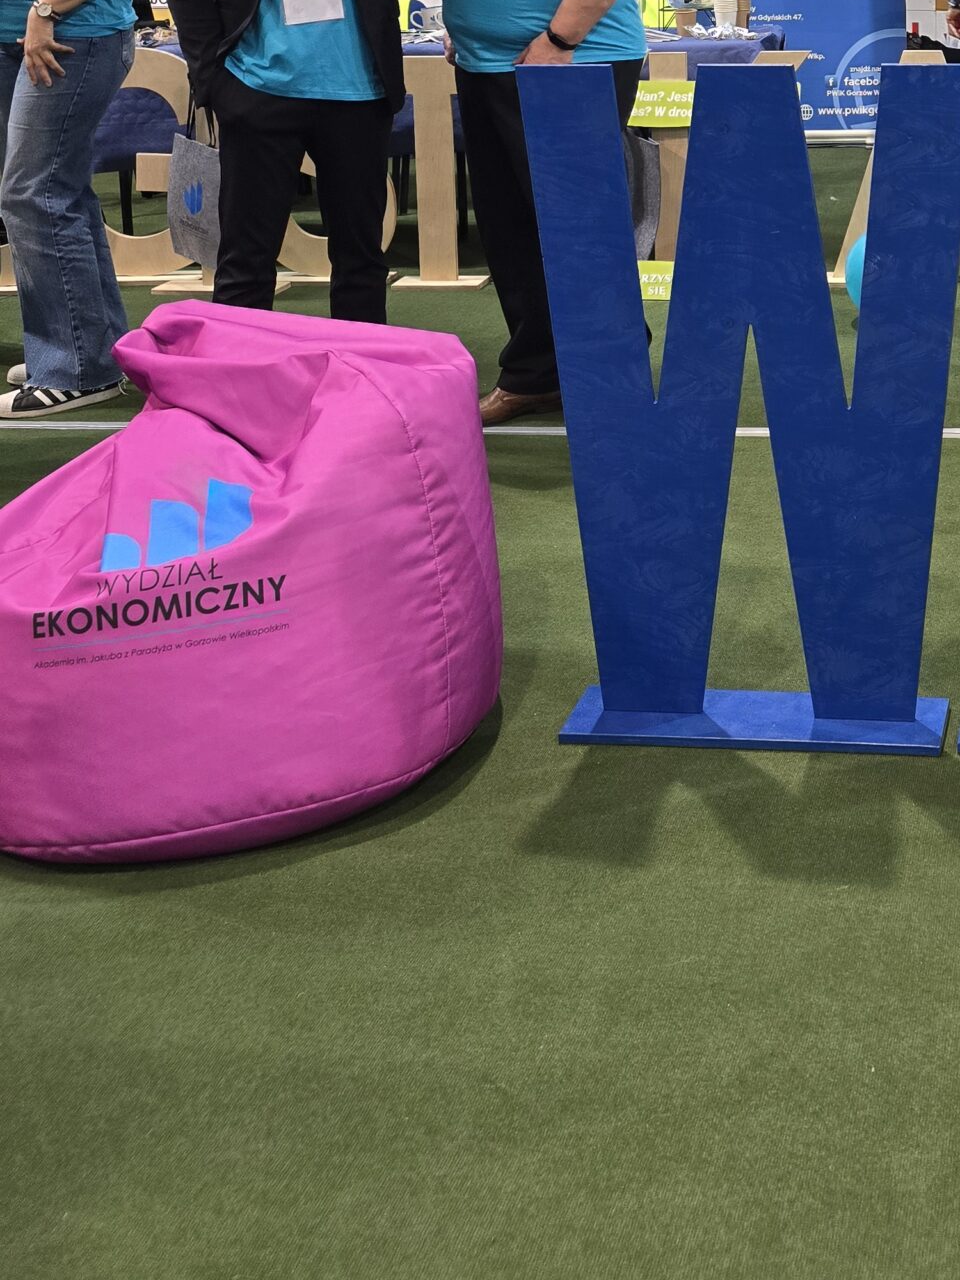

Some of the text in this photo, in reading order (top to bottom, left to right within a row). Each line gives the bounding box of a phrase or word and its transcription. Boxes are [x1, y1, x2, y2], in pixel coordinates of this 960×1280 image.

[655, 105, 667, 117] W
[96, 558, 223, 598] WYDZIAŁ
[33, 574, 286, 639] EKONOMICZNY
[34, 622, 289, 669] Akademia im. Jakuba Paradyża Gorzowie Wielkopolskim
